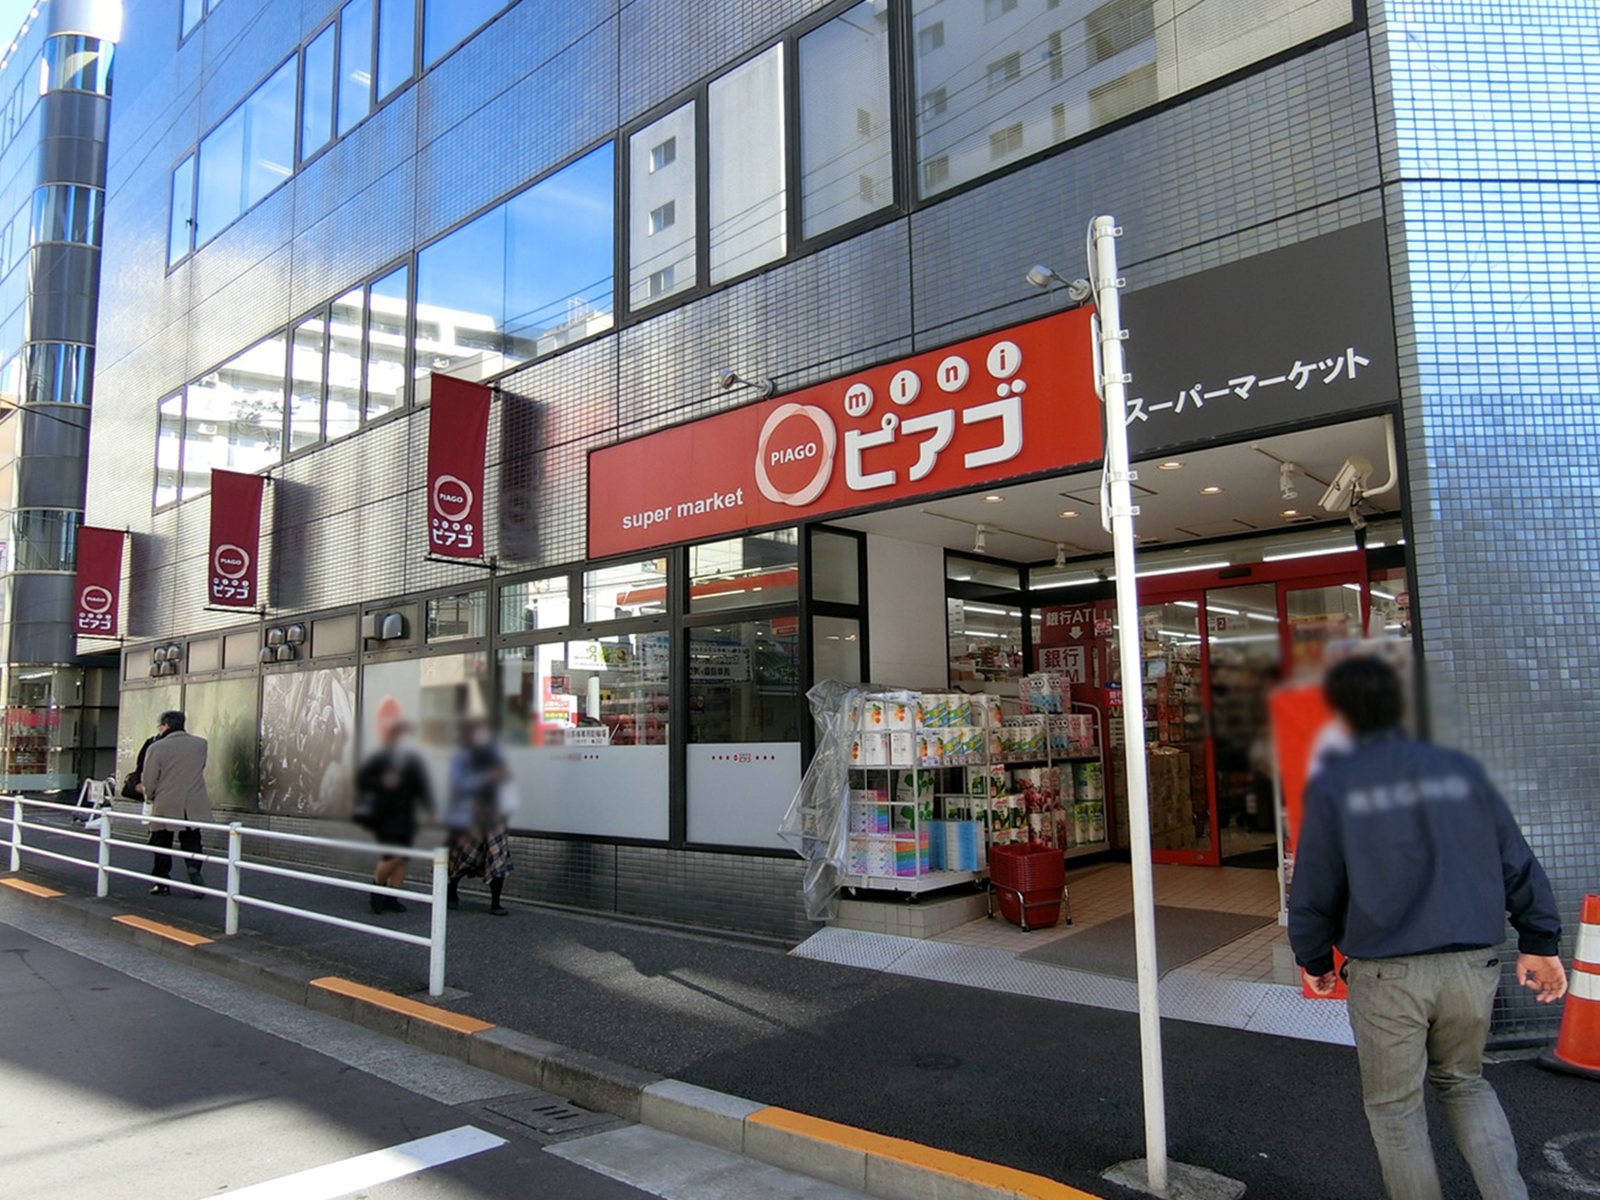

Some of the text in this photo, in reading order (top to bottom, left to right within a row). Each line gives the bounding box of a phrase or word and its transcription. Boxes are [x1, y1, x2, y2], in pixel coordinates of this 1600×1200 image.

[847, 346, 1009, 411] mini
[1125, 346, 1371, 426] スーパーマーケット
[843, 378, 1028, 492] ピアゴ
[770, 441, 818, 467] PIAGO
[438, 492, 464, 504] PIAGO
[621, 487, 744, 531] super market
[432, 528, 474, 548] ピアゴ
[219, 557, 242, 566] PIAGO
[212, 585, 250, 600] ピアゴ
[78, 618, 112, 630] ピアゴ
[1044, 648, 1080, 669] 銀行
